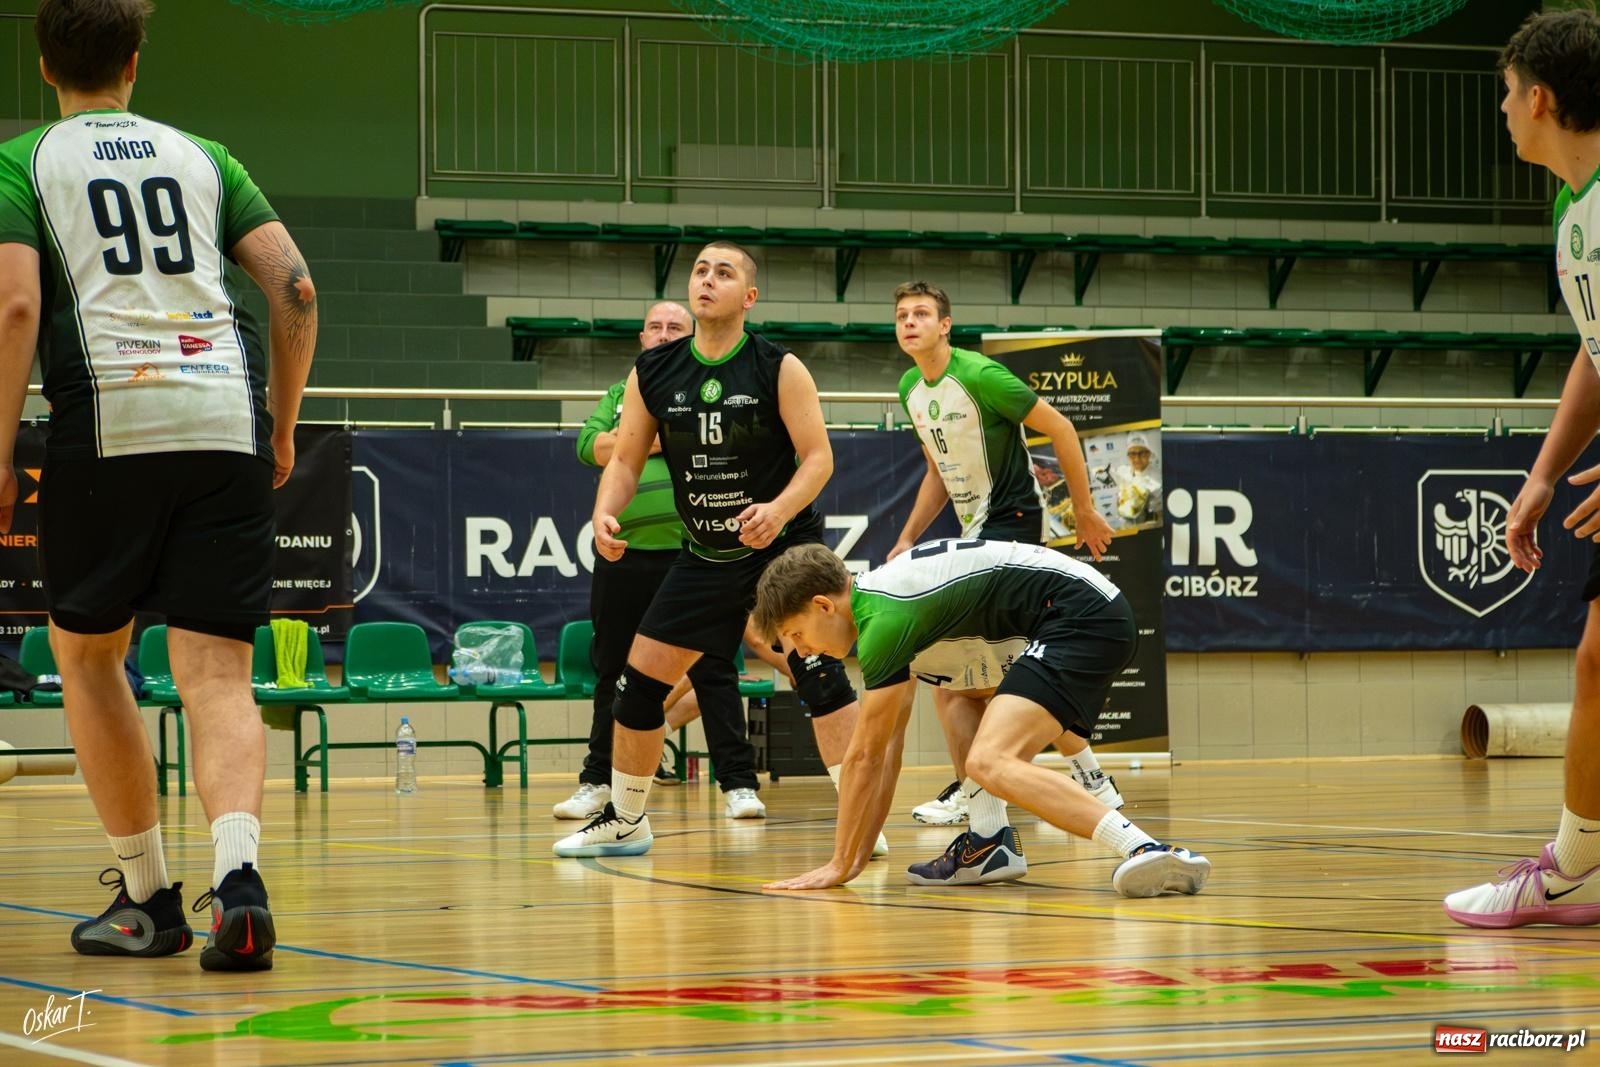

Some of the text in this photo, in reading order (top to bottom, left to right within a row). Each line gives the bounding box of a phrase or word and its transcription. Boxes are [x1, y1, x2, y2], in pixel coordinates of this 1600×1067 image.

[93, 137, 157, 160] JOŃCA
[87, 176, 195, 276] 99
[116, 339, 160, 350] PIVEXIN
[182, 342, 211, 350] VANESSA
[1028, 371, 1118, 391] SZYPUŁA
[1056, 394, 1111, 404] MISTRZOWSKIE
[698, 412, 723, 445] 15
[930, 428, 948, 454] 16
[707, 491, 745, 500] CONCEPT
[708, 497, 753, 507] automatic
[1162, 488, 1258, 567] iR
[275, 536, 332, 548] DANIU
[295, 580, 331, 589] WIĘCEJ
[1163, 570, 1258, 597] CIBÓRZ
[6, 626, 23, 634] 110
